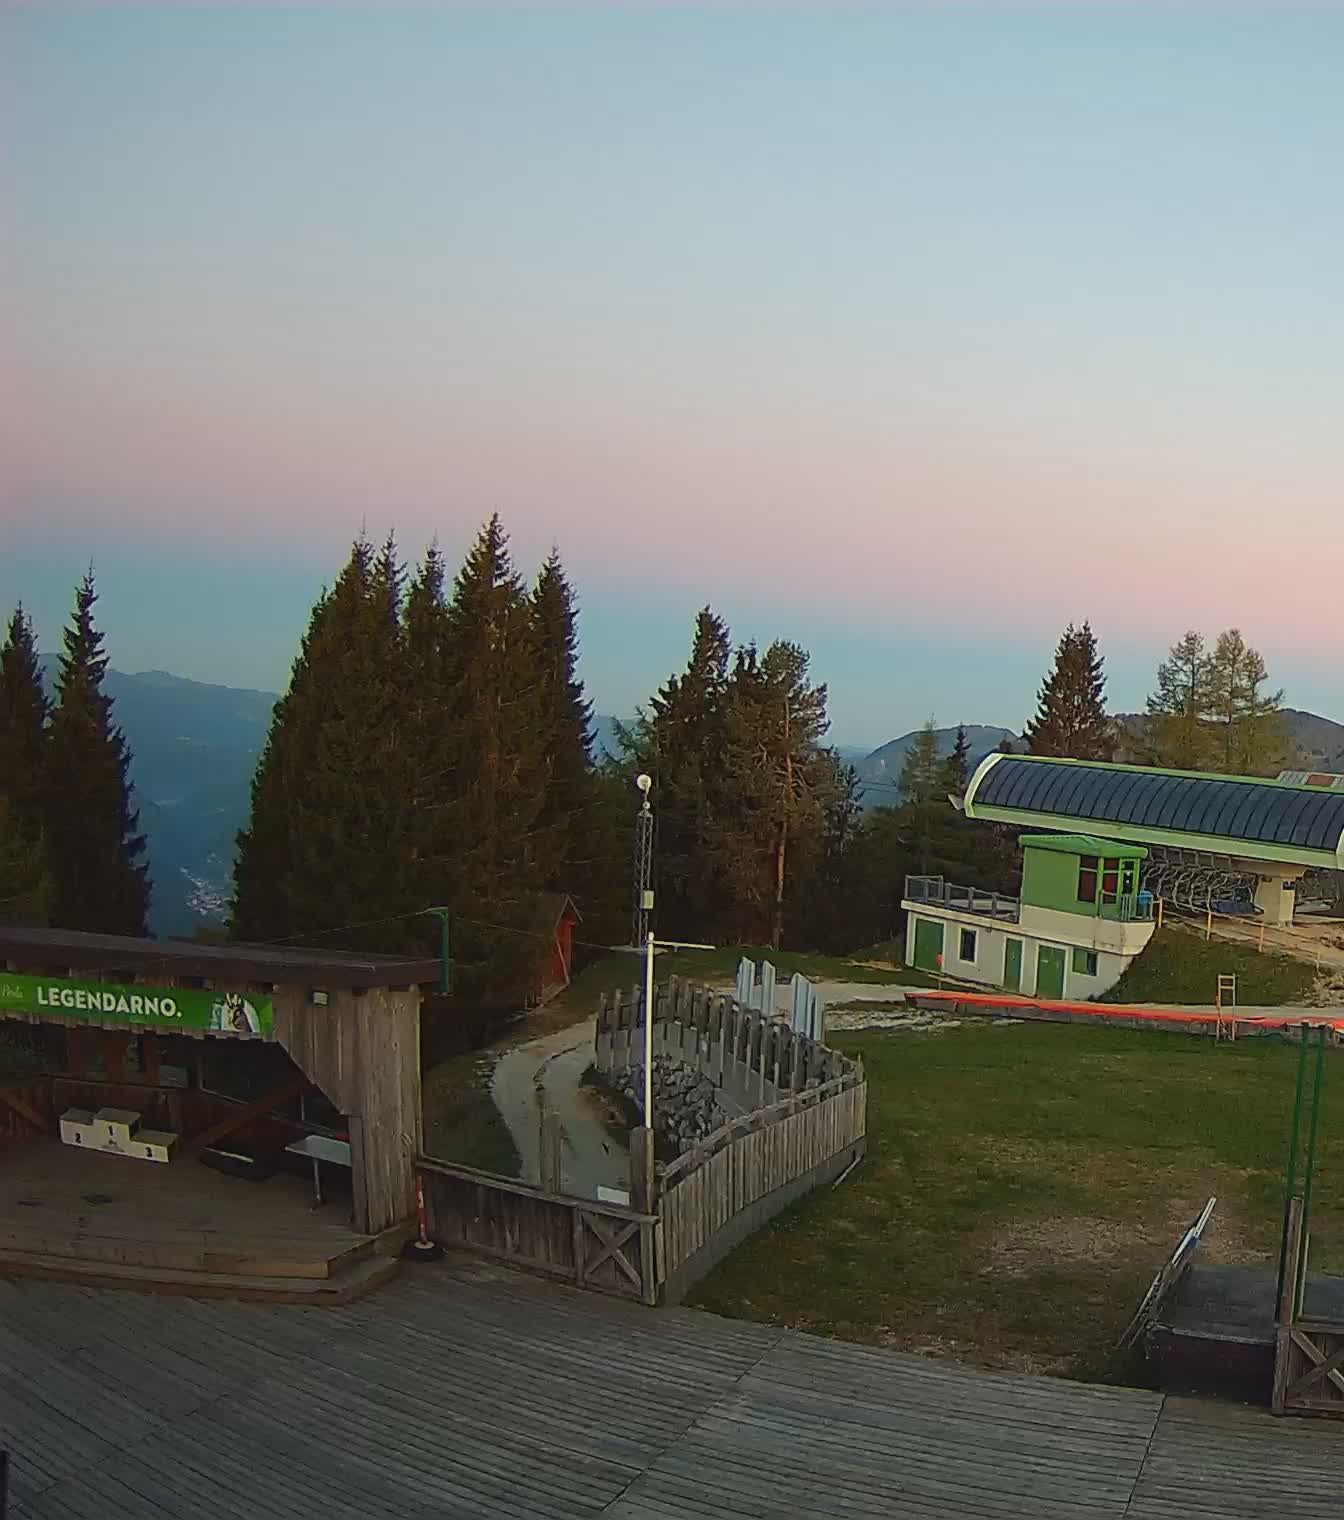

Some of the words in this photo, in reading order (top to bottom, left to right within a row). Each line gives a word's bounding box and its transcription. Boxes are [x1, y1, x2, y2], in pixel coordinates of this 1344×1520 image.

[37, 985, 183, 1018] LEGENDARNO.
[75, 1132, 82, 1144] 2
[145, 1146, 153, 1158] 3
